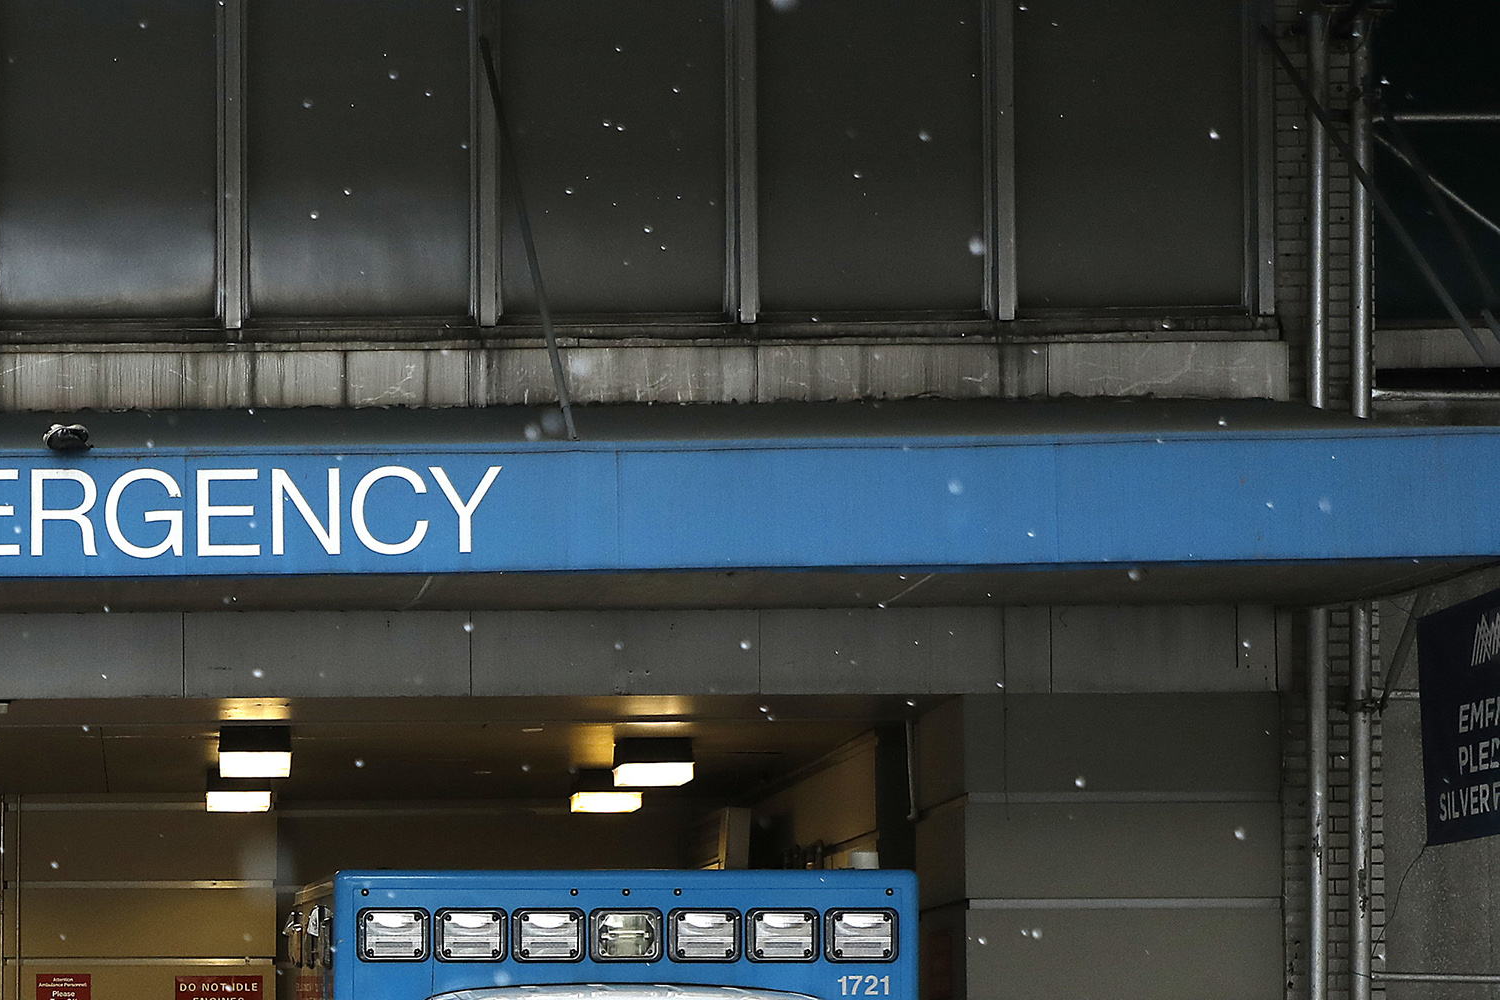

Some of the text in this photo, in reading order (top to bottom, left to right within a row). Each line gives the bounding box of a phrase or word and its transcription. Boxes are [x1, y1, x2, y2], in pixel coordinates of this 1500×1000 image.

[179, 982, 258, 992] DO NOT IDLE
[837, 975, 890, 996] 1721
